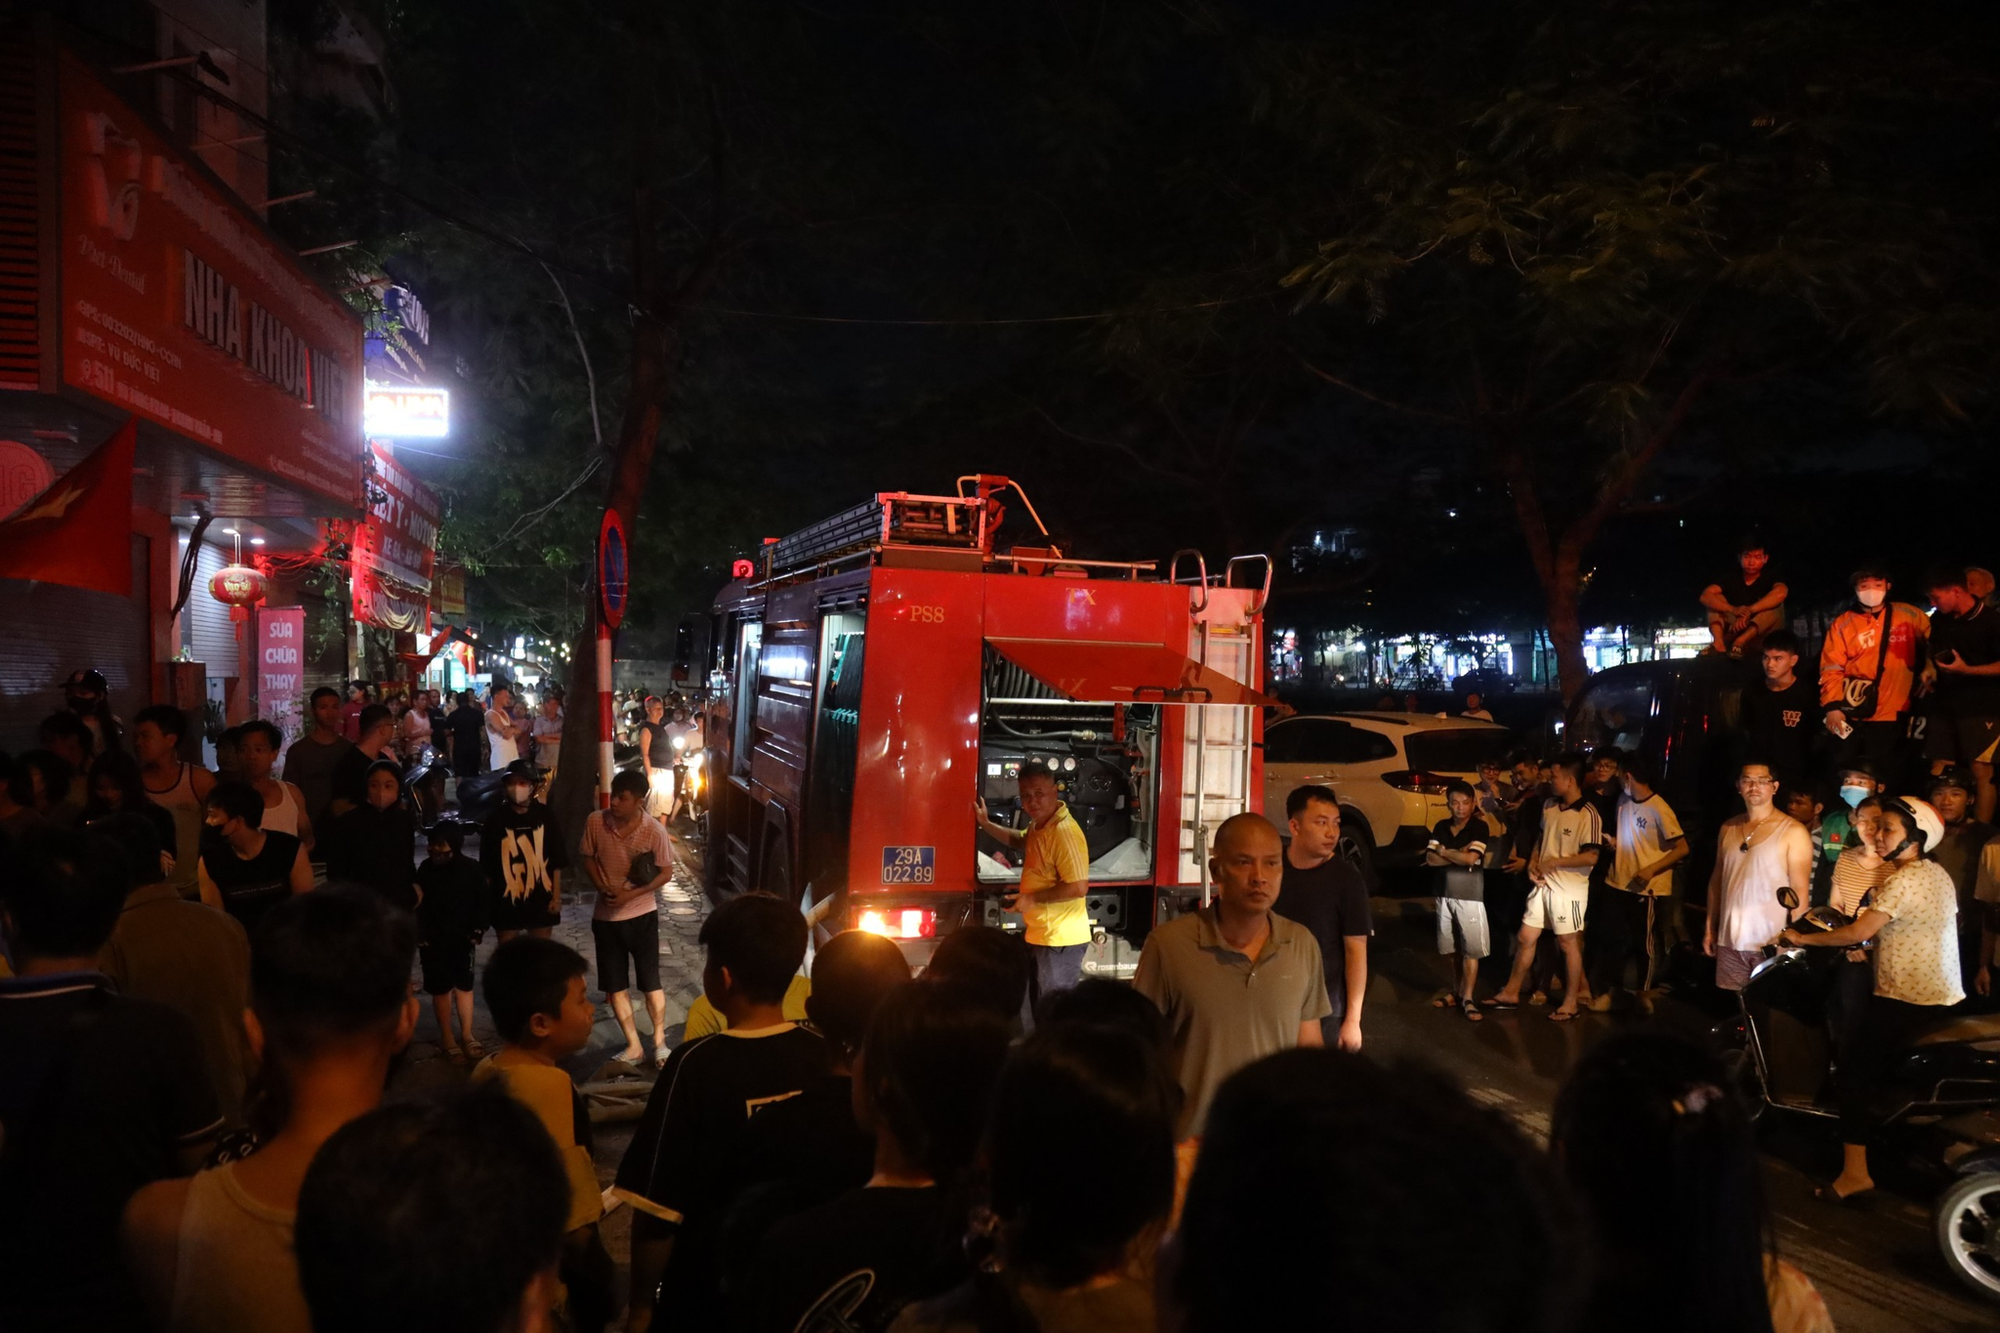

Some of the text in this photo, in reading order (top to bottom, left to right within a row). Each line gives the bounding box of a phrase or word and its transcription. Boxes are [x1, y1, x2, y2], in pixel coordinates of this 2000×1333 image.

[909, 605, 945, 623] PS8
[265, 673, 297, 691] THAY
[894, 848, 922, 865] 29A
[883, 866, 933, 883] 022.89
